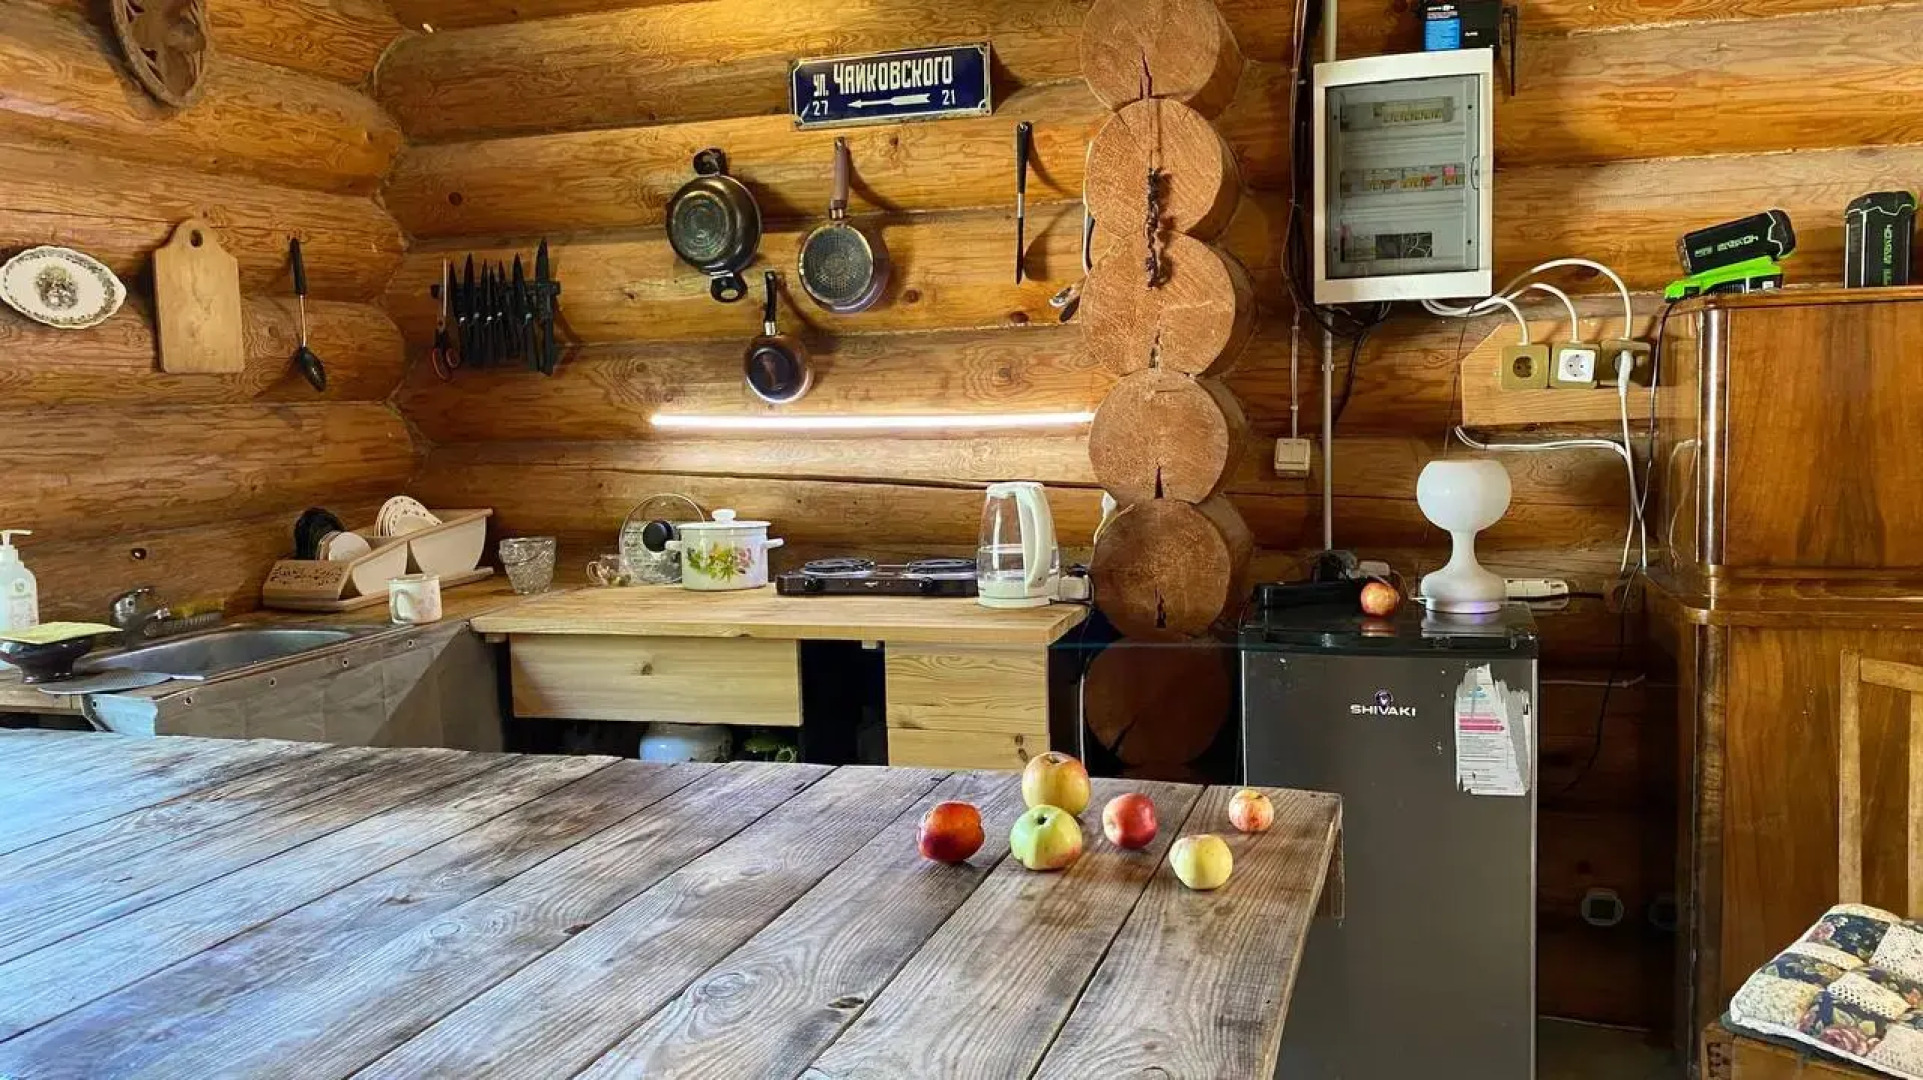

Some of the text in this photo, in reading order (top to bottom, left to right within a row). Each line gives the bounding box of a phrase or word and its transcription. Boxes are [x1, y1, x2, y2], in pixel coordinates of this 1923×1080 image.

[812, 55, 953, 98] УЛ. ЧАЙКОВСКОГО
[942, 89, 957, 106] 21
[812, 100, 829, 116] 27
[1350, 704, 1416, 717] SHIVAKI
